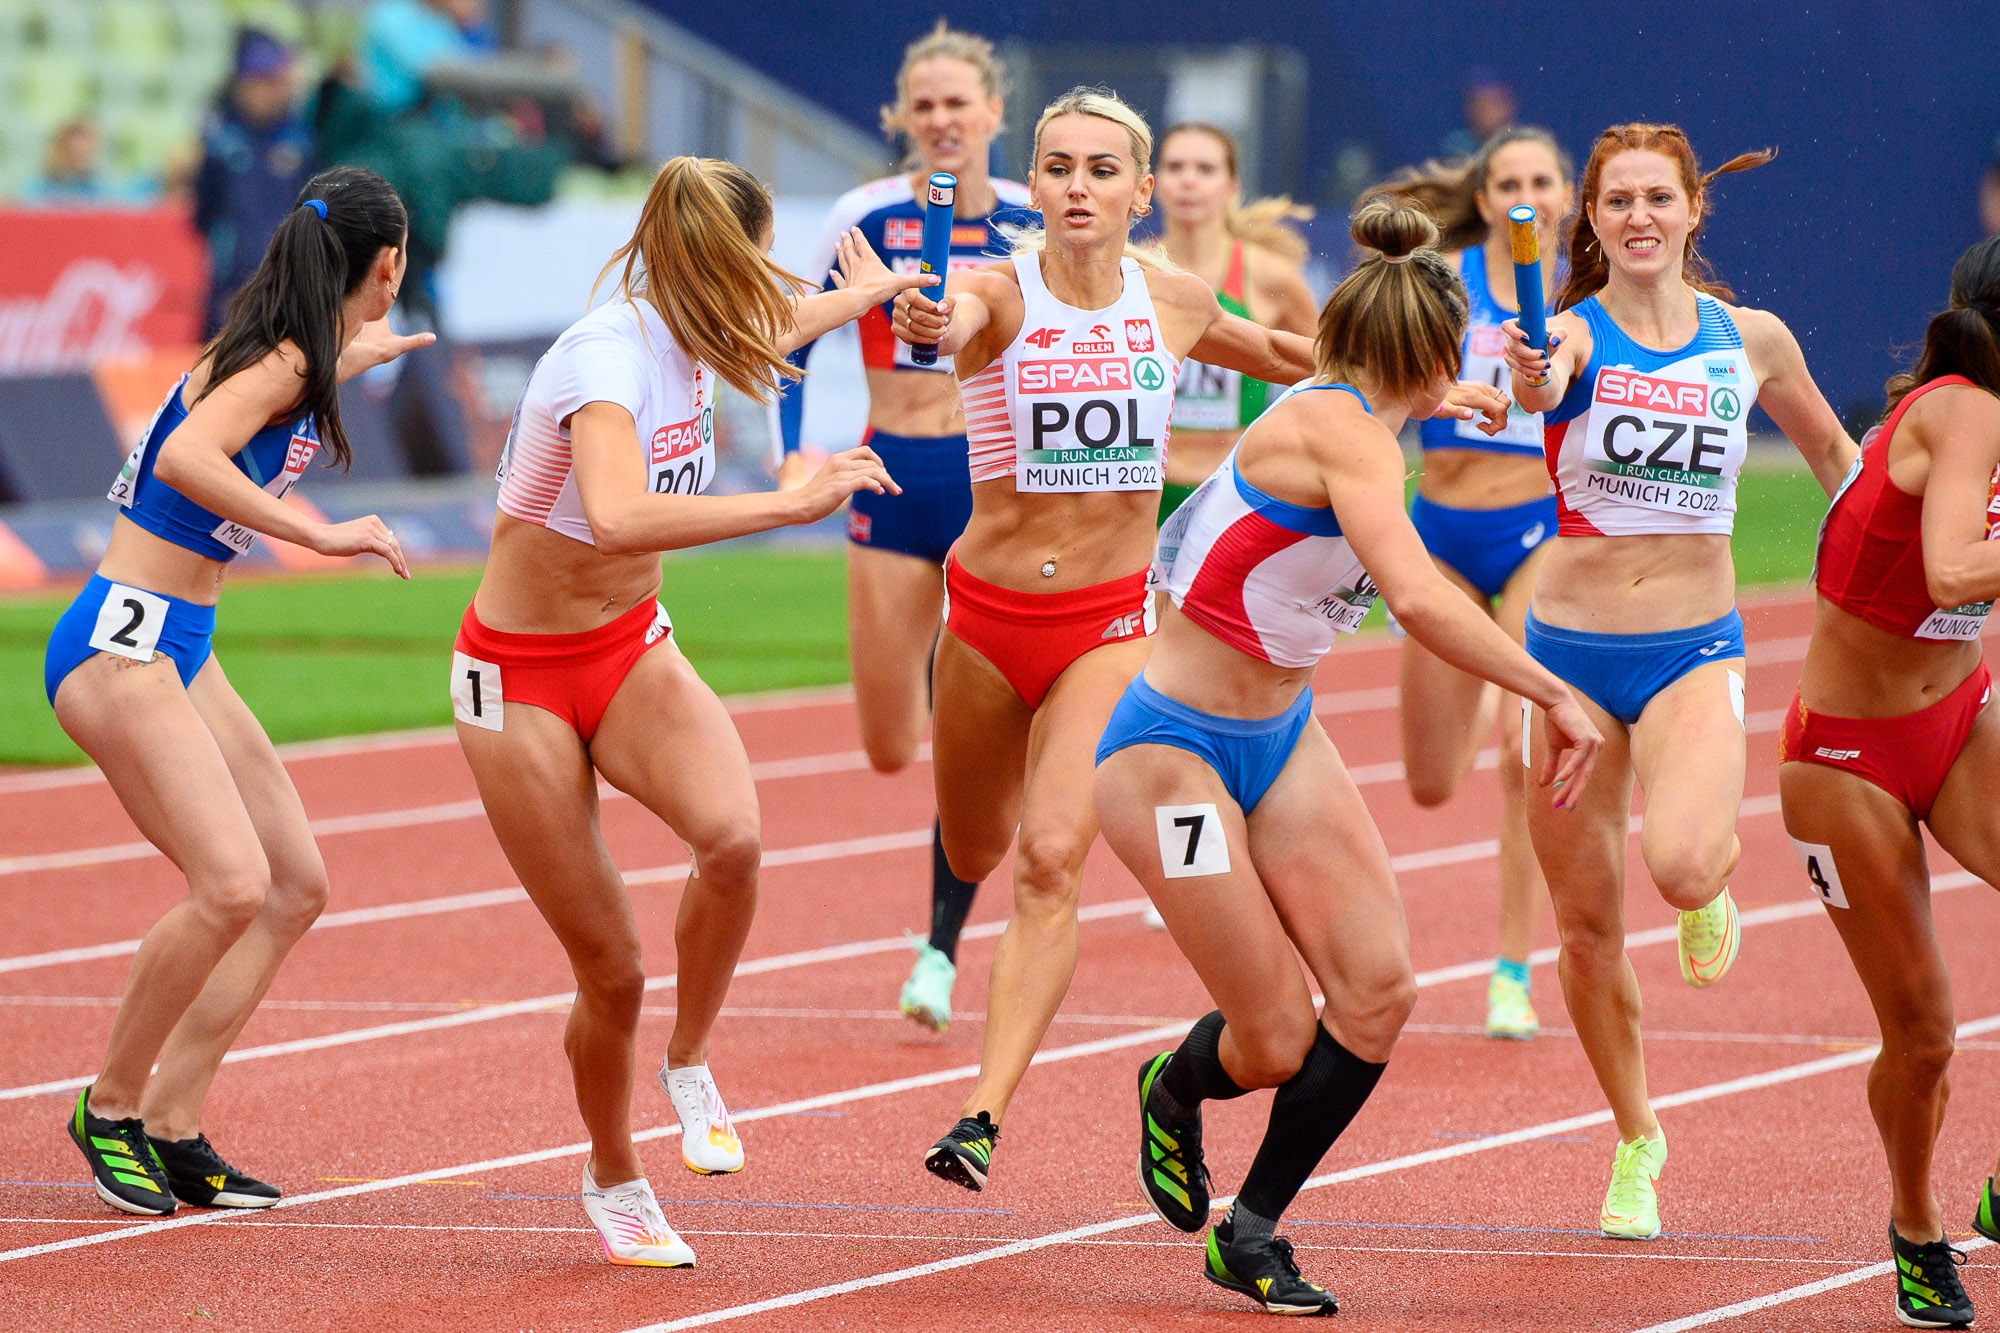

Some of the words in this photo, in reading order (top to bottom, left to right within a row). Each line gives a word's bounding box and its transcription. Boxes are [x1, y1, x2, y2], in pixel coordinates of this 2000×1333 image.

[1025, 328, 1066, 349] 4F
[1074, 343, 1112, 353] ORLEN
[1021, 362, 1128, 389] SPAR
[1600, 374, 1704, 412] SPAR
[1032, 399, 1155, 450] POL
[652, 426, 701, 459] SPAR
[1053, 451, 1058, 462] I
[1061, 450, 1090, 462] RUN
[1602, 414, 1728, 476] CZE
[1026, 467, 1110, 486] MUNICH
[1118, 466, 1157, 484] 2022
[1618, 465, 1623, 475] I
[1626, 466, 1655, 480] RUN
[1587, 474, 1670, 504] MUNICH
[1677, 490, 1718, 512] 2022
[109, 598, 145, 648] 2
[1101, 609, 1143, 639] 4F
[1925, 617, 1984, 636] MUNICH
[466, 669, 482, 718] 1
[1815, 747, 1862, 761] ESP
[1173, 814, 1206, 866] 7
[1807, 855, 1831, 898] 4
